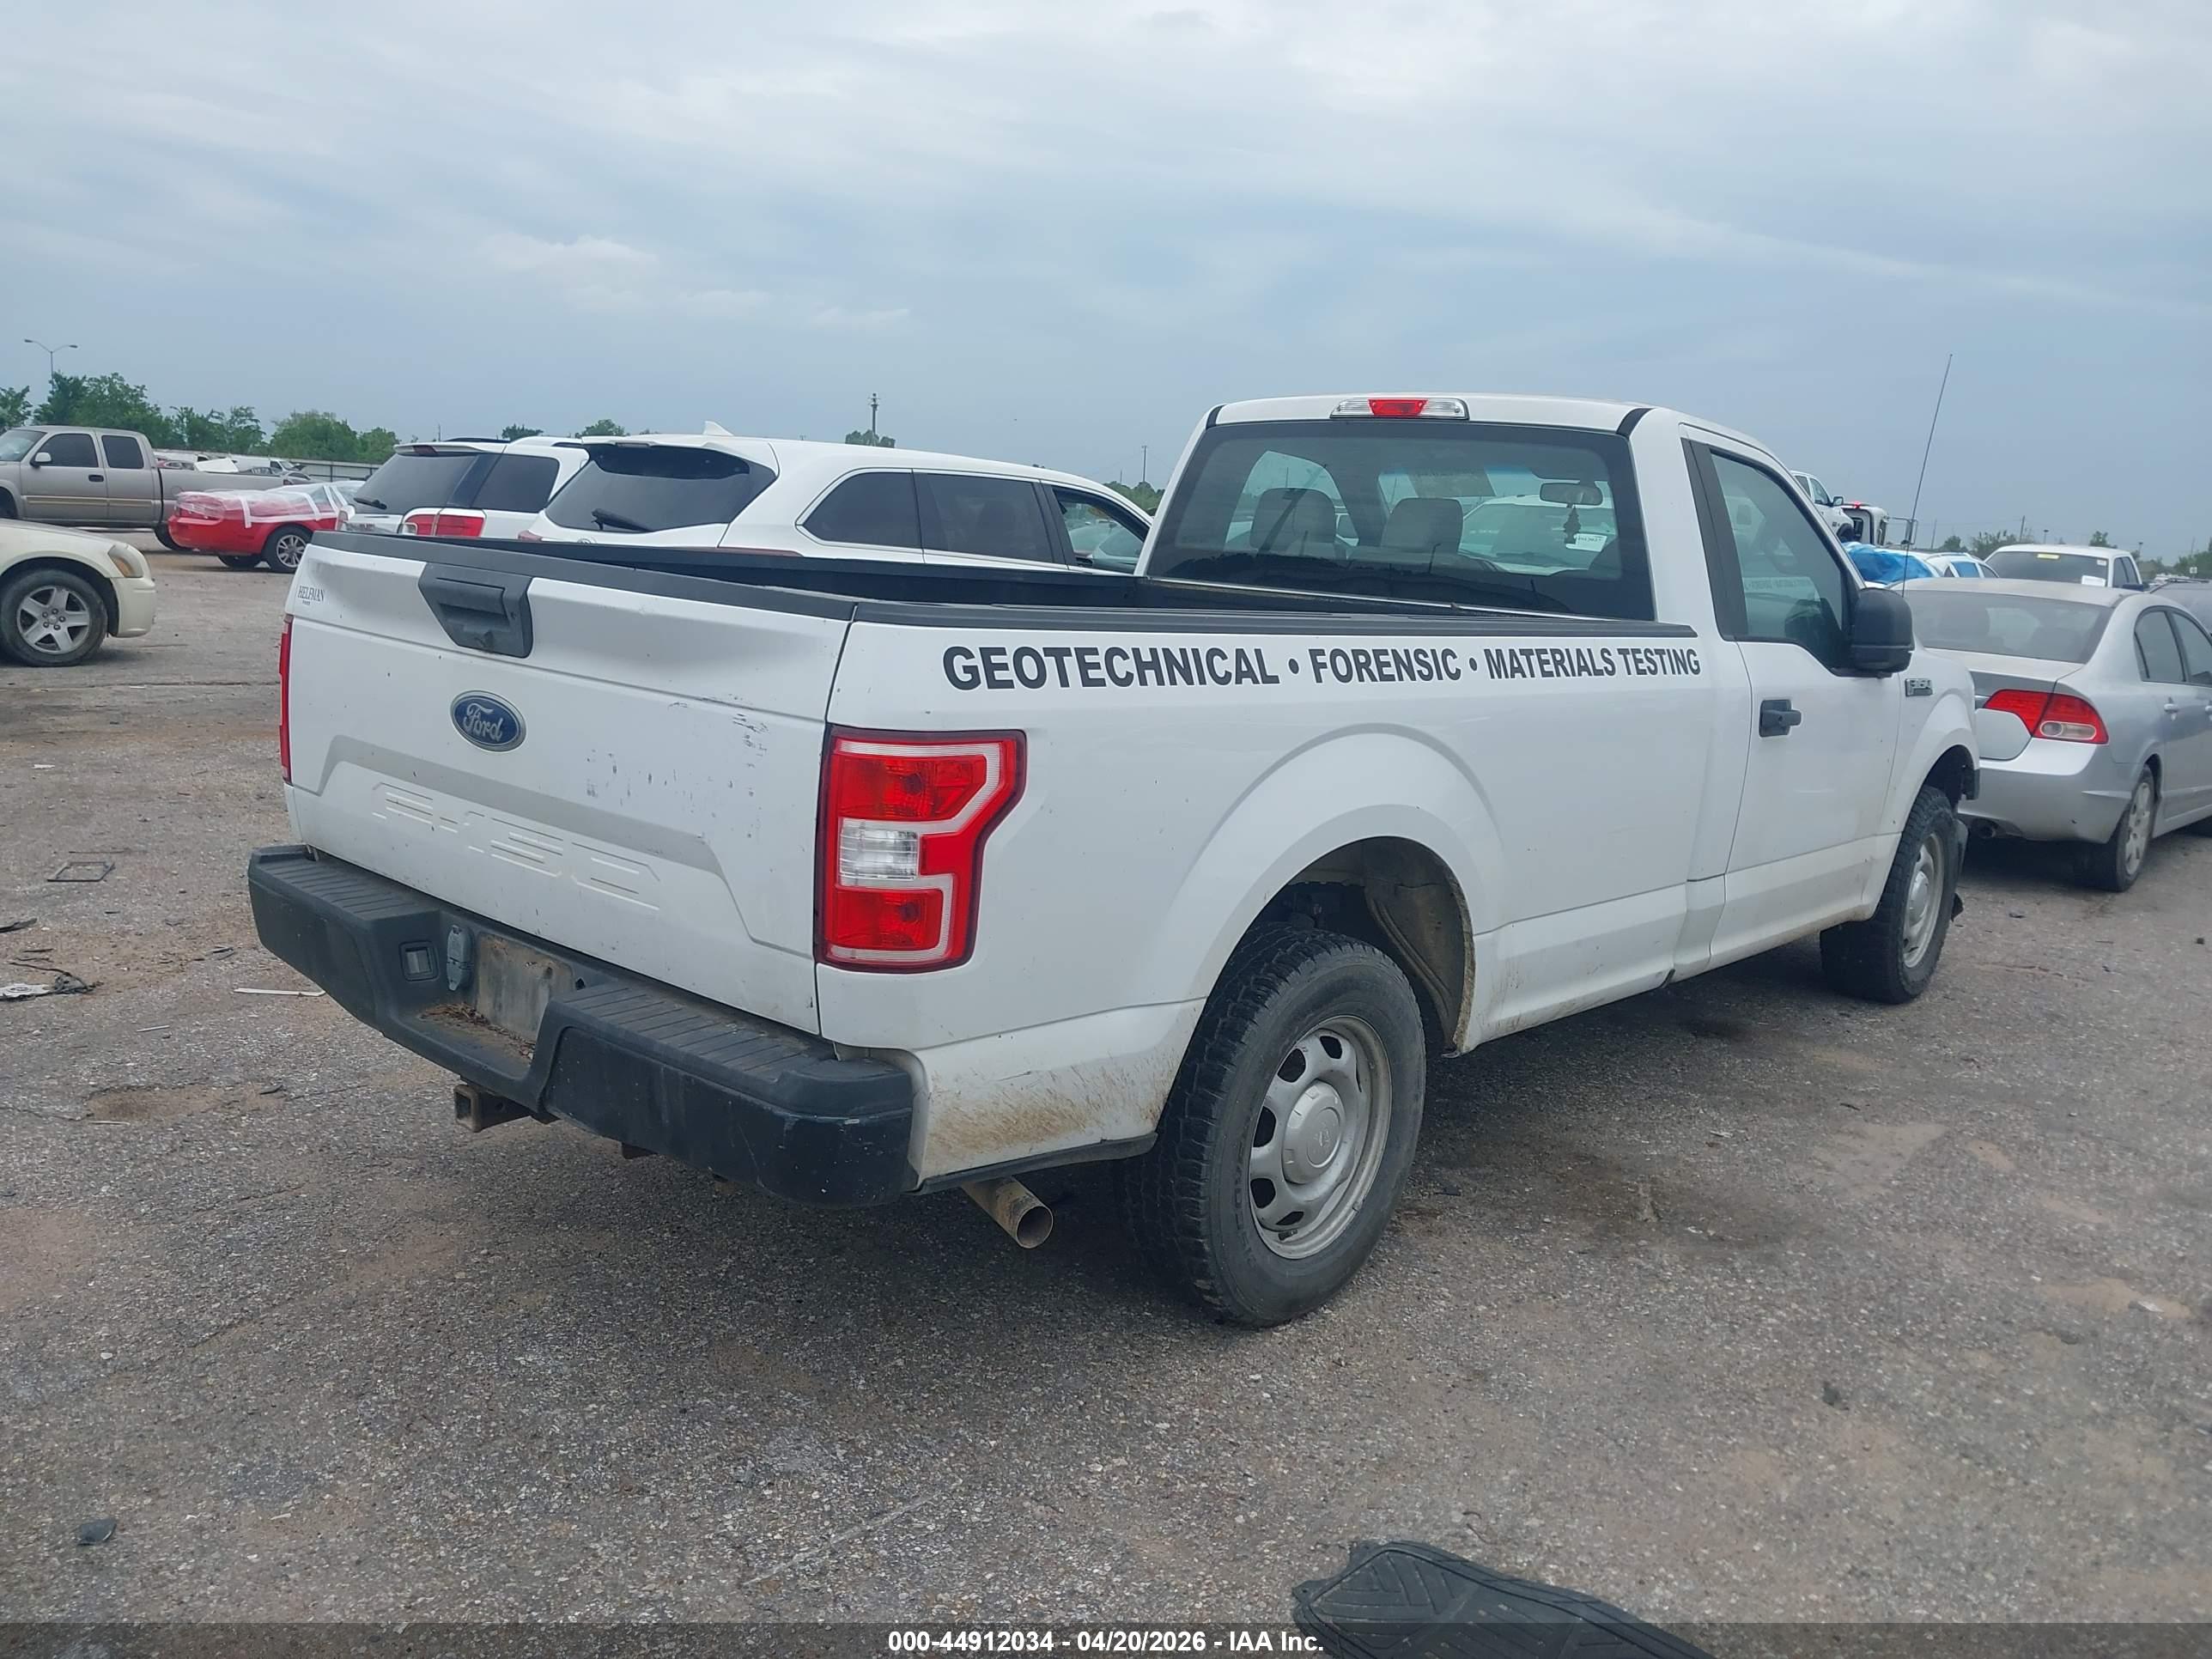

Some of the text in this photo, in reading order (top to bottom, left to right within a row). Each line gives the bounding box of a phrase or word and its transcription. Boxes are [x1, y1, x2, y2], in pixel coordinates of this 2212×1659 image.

[943, 646, 1280, 690] GEOTECHNICAL
[1308, 648, 1462, 684] FORENSIC
[1483, 648, 1617, 679] MATERIALS
[1617, 647, 1702, 677] TESTING
[462, 702, 504, 742] Ford
